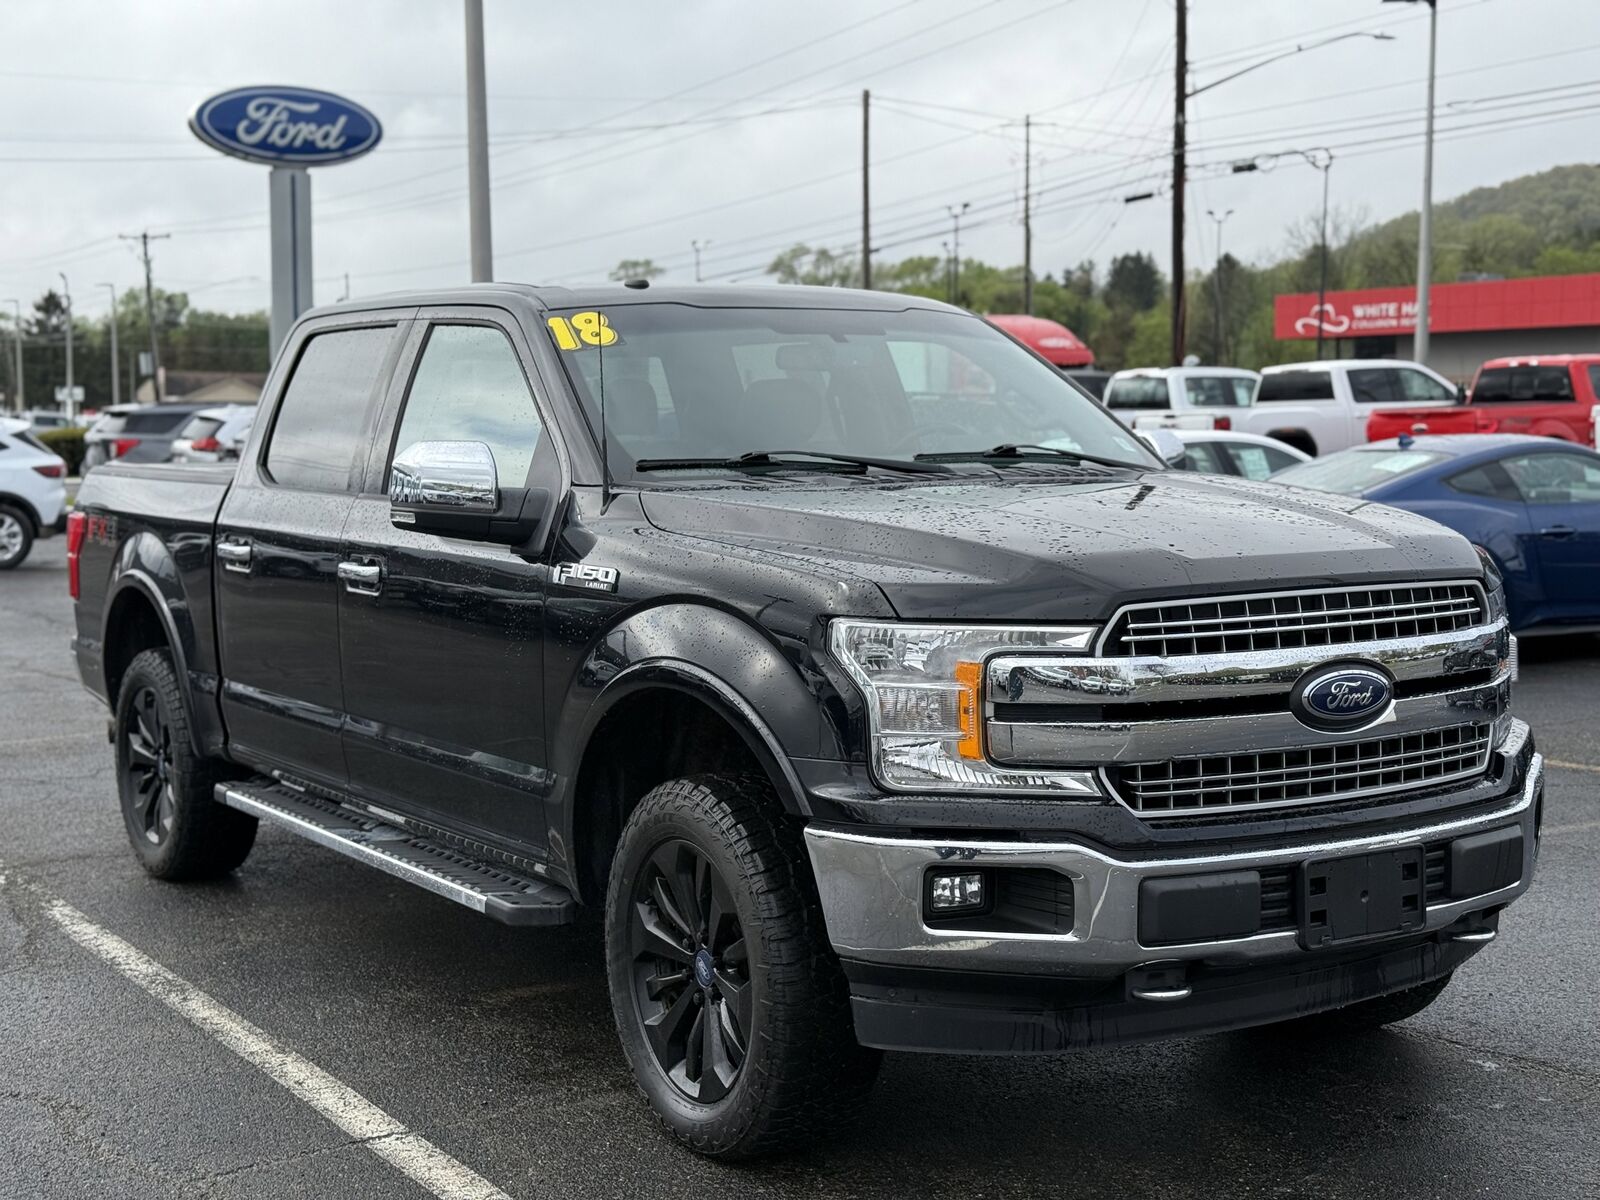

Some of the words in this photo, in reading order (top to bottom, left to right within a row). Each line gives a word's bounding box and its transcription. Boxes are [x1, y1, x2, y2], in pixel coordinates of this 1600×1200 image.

[236, 97, 346, 149] Ford
[1352, 302, 1399, 318] WHITE
[1401, 301, 1431, 317] HA
[547, 311, 618, 350] 18
[585, 581, 608, 590] LARIAT
[1327, 681, 1373, 709] Ford
